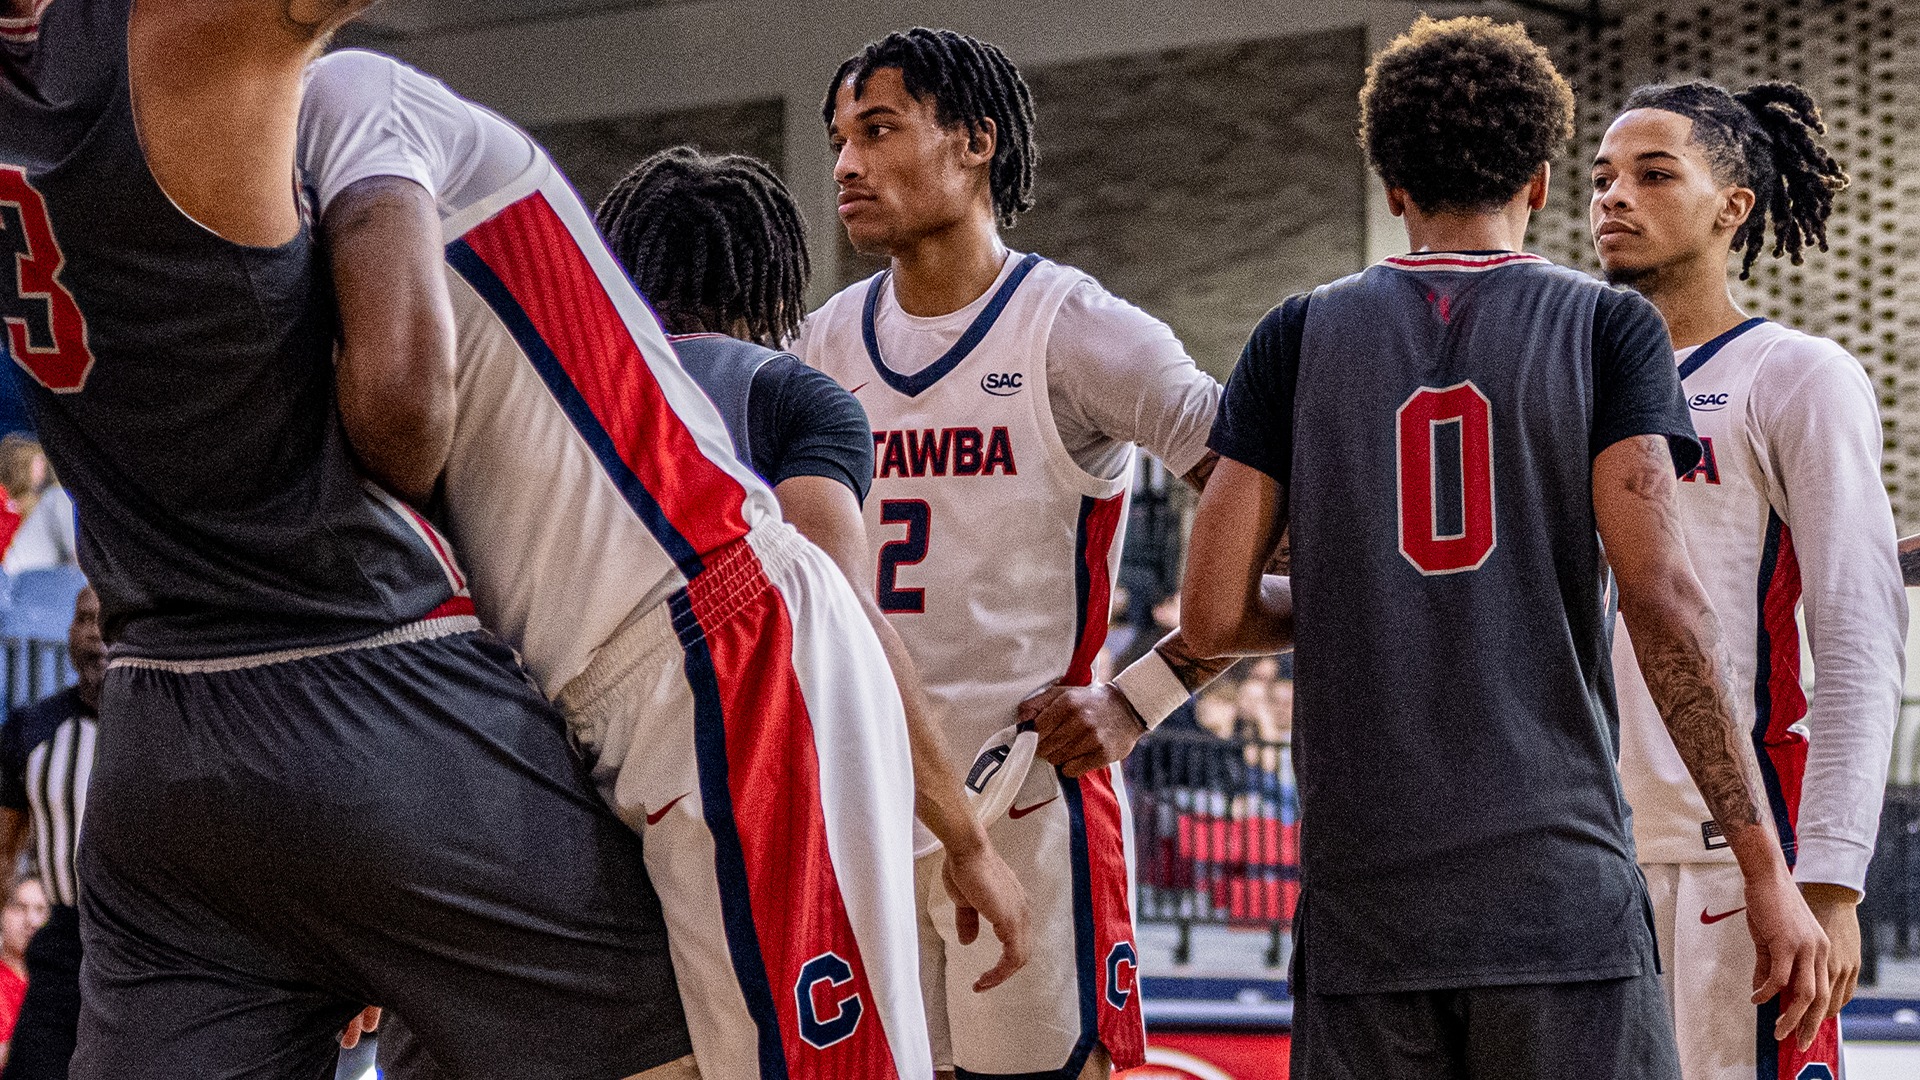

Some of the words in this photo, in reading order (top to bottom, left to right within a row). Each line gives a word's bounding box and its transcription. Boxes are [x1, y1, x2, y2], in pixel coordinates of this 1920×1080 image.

[0, 163, 95, 393] 3
[985, 373, 1023, 389] SAC
[1693, 393, 1728, 406] SAC
[1396, 379, 1496, 576] 0
[876, 498, 931, 614] 2
[794, 950, 864, 1050] C
